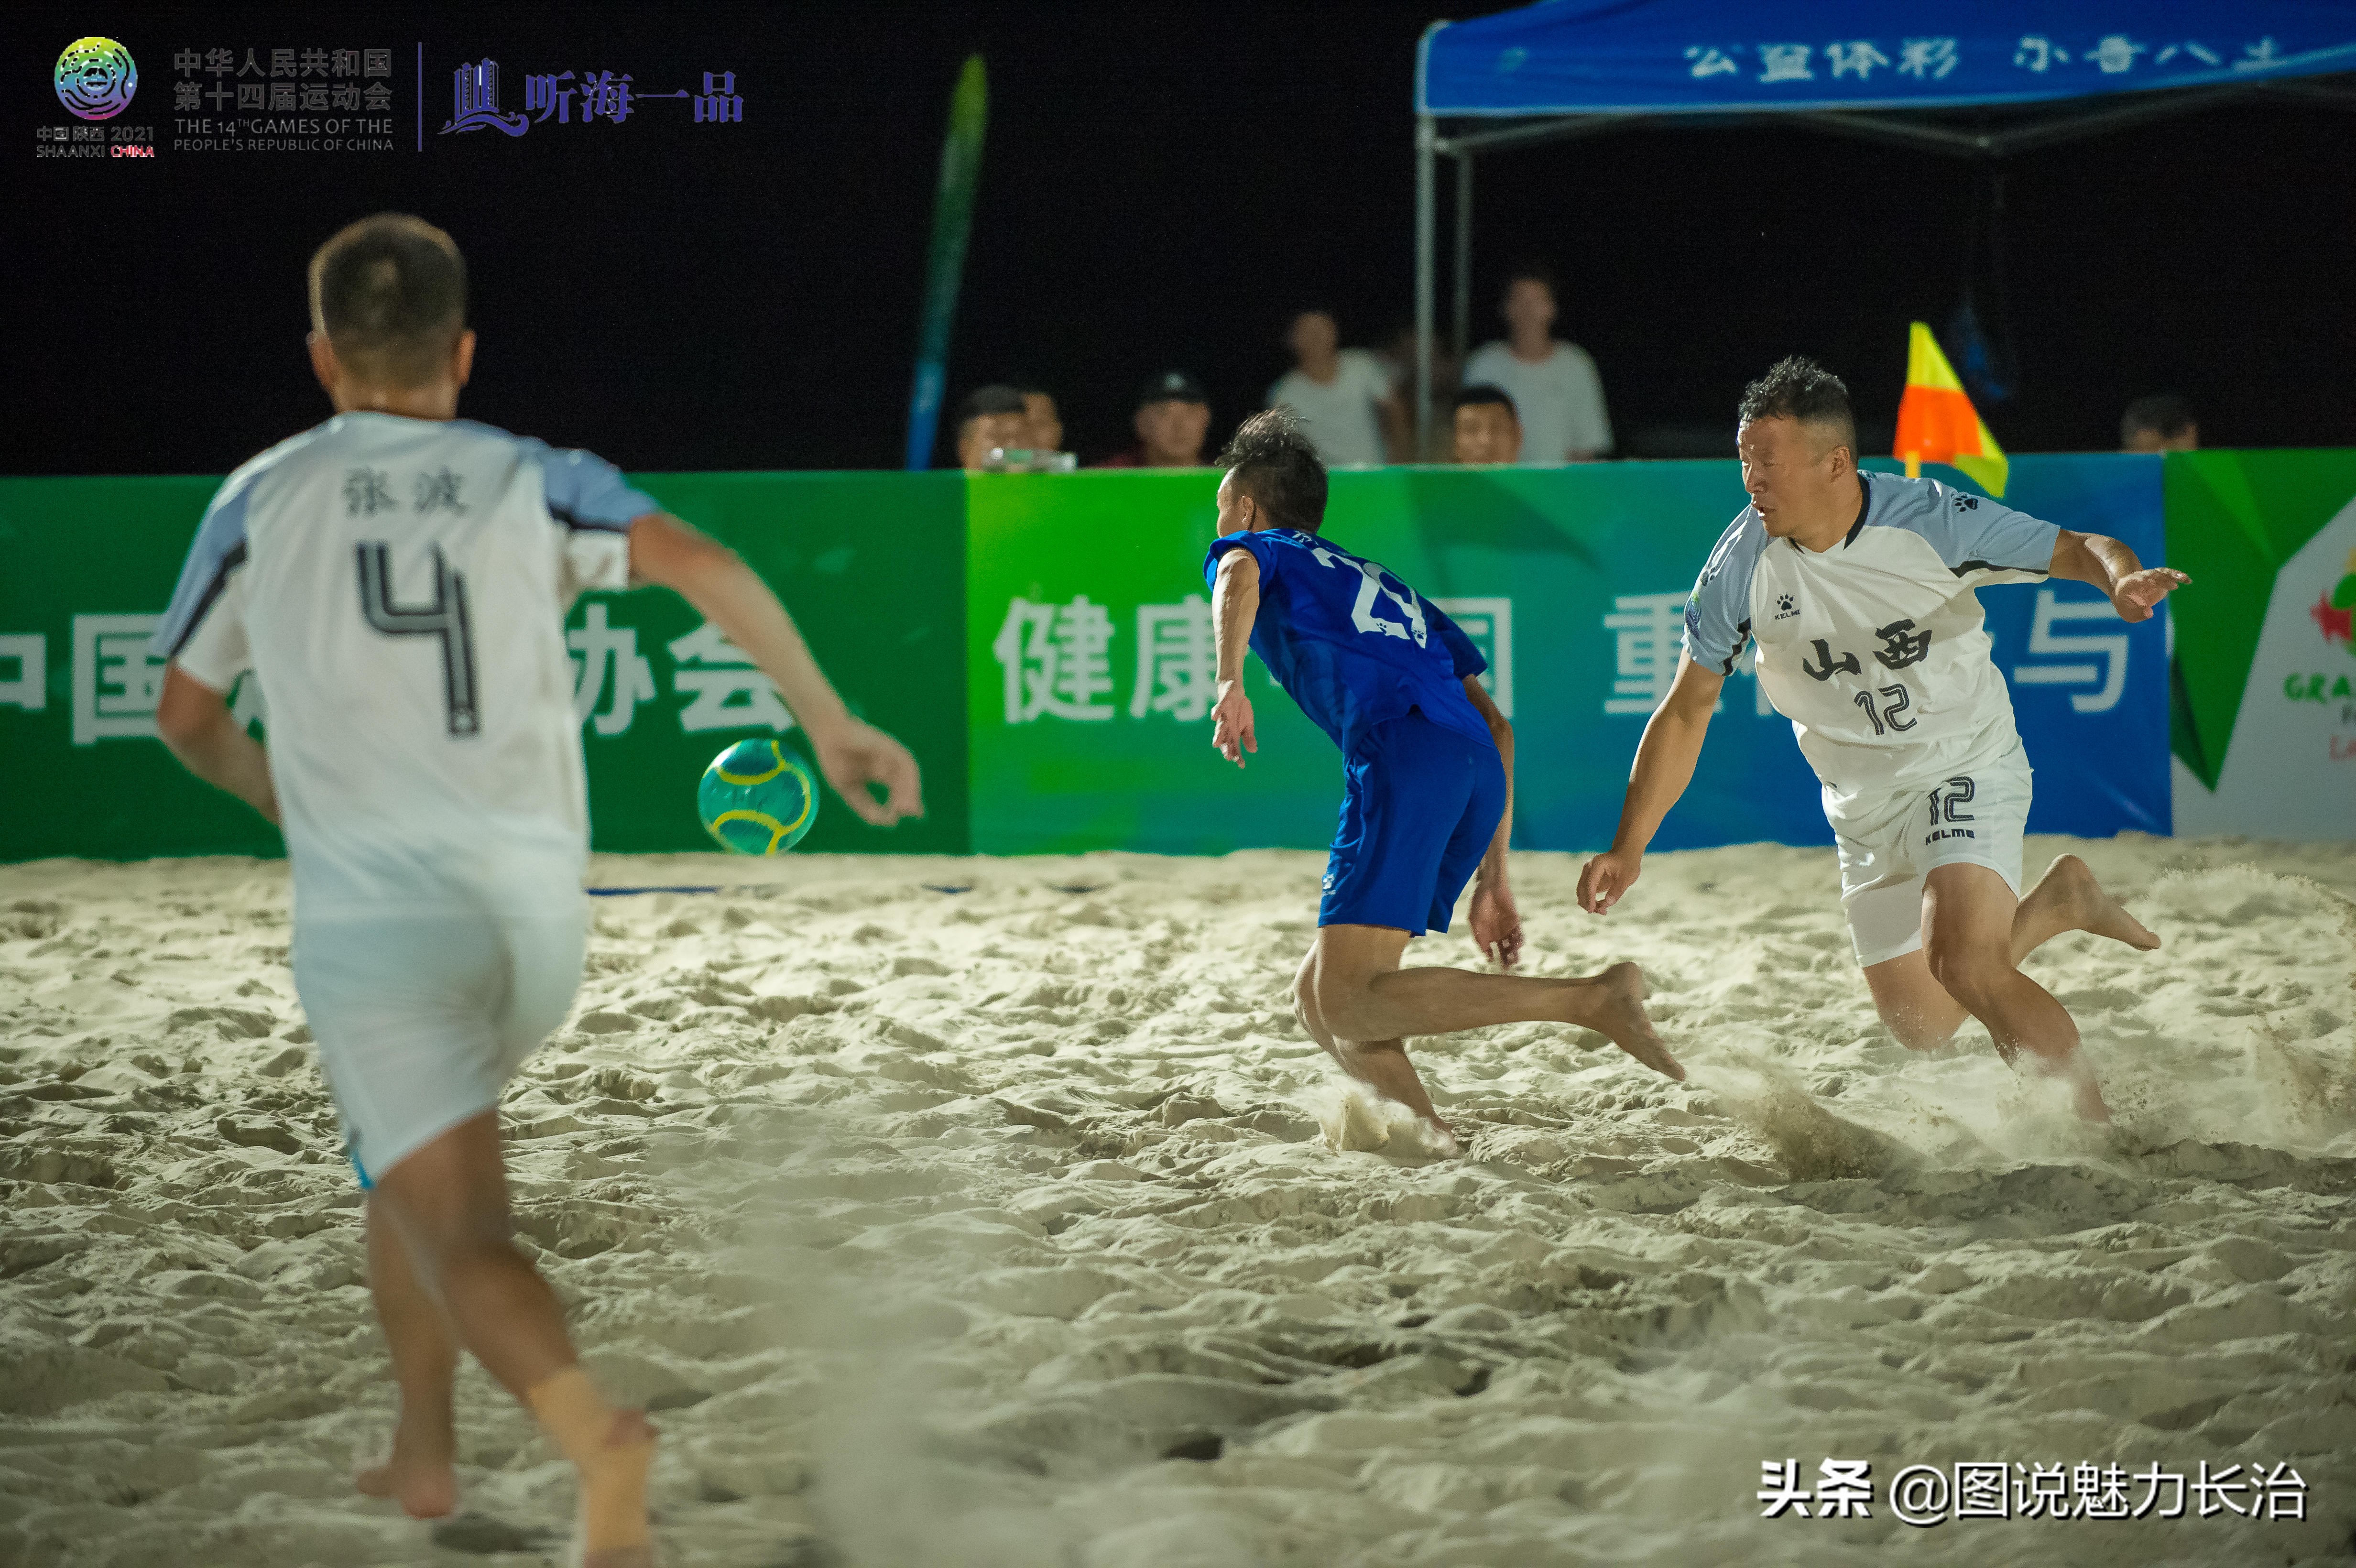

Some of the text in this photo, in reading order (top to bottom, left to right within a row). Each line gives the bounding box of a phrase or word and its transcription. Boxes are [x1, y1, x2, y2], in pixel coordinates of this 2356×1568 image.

[354, 539, 480, 739] 4
[1802, 618, 1933, 682] 山西
[1854, 683, 1918, 736] 12
[1927, 776, 1975, 826] 12
[1925, 828, 1975, 846] KELME
